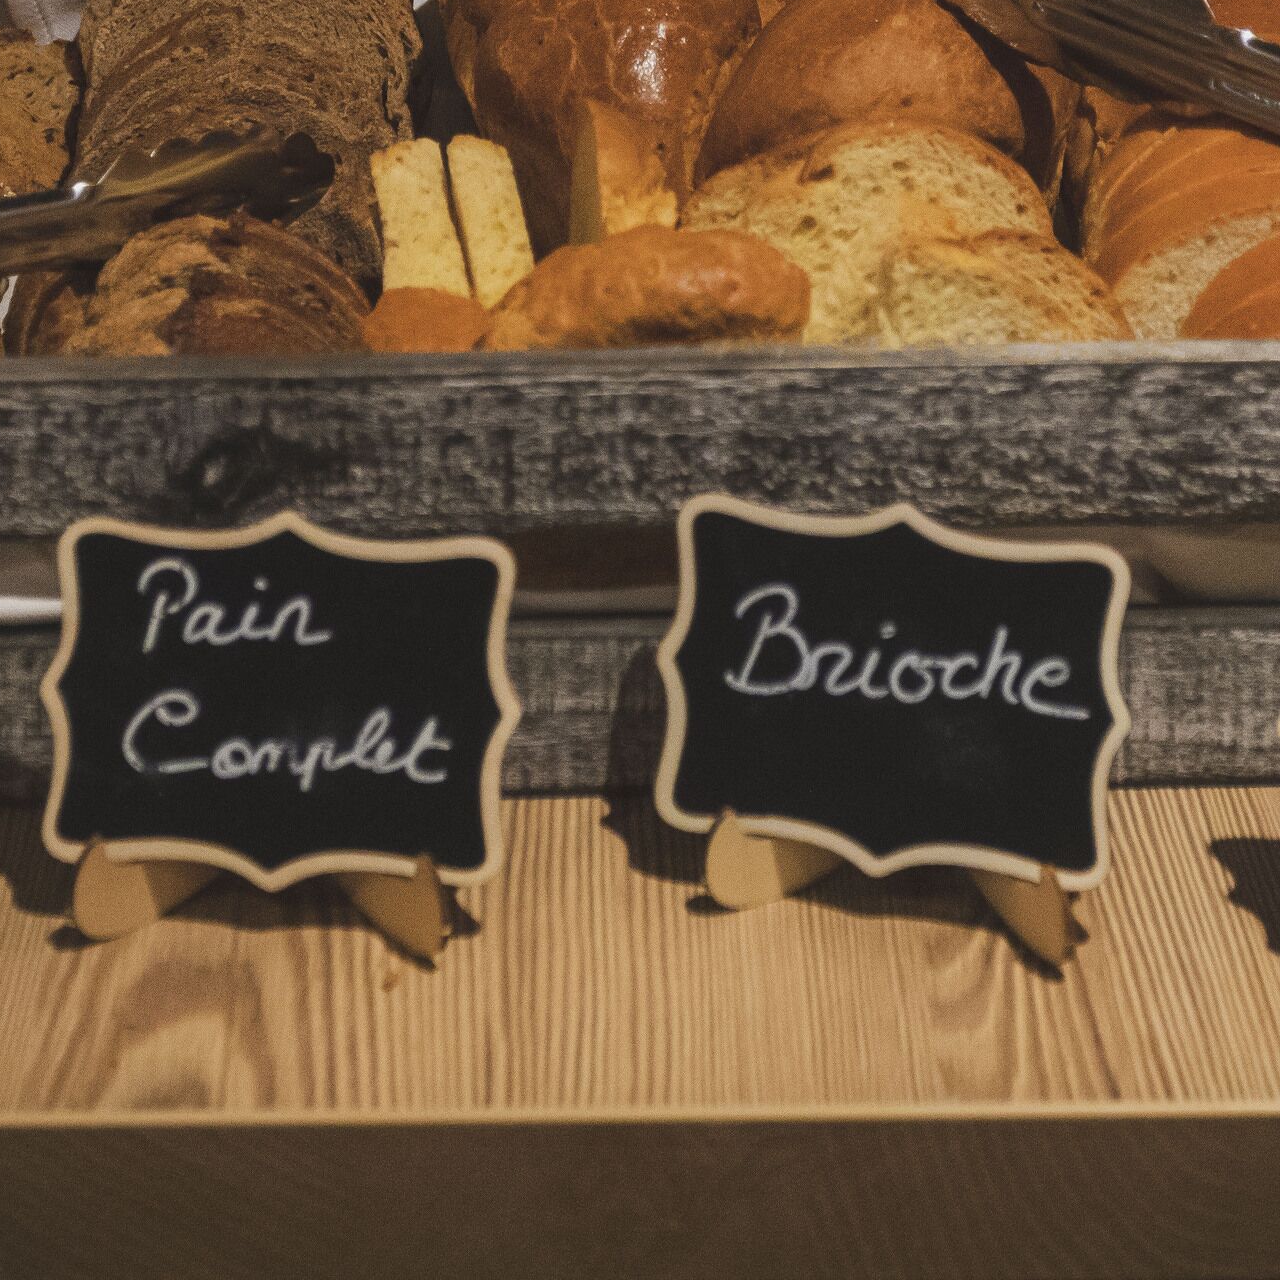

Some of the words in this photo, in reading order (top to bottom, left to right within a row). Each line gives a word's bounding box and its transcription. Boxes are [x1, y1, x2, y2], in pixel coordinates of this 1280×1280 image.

[137, 557, 333, 654] Pain
[724, 583, 1091, 721] Brioche
[121, 688, 454, 793] Complet
